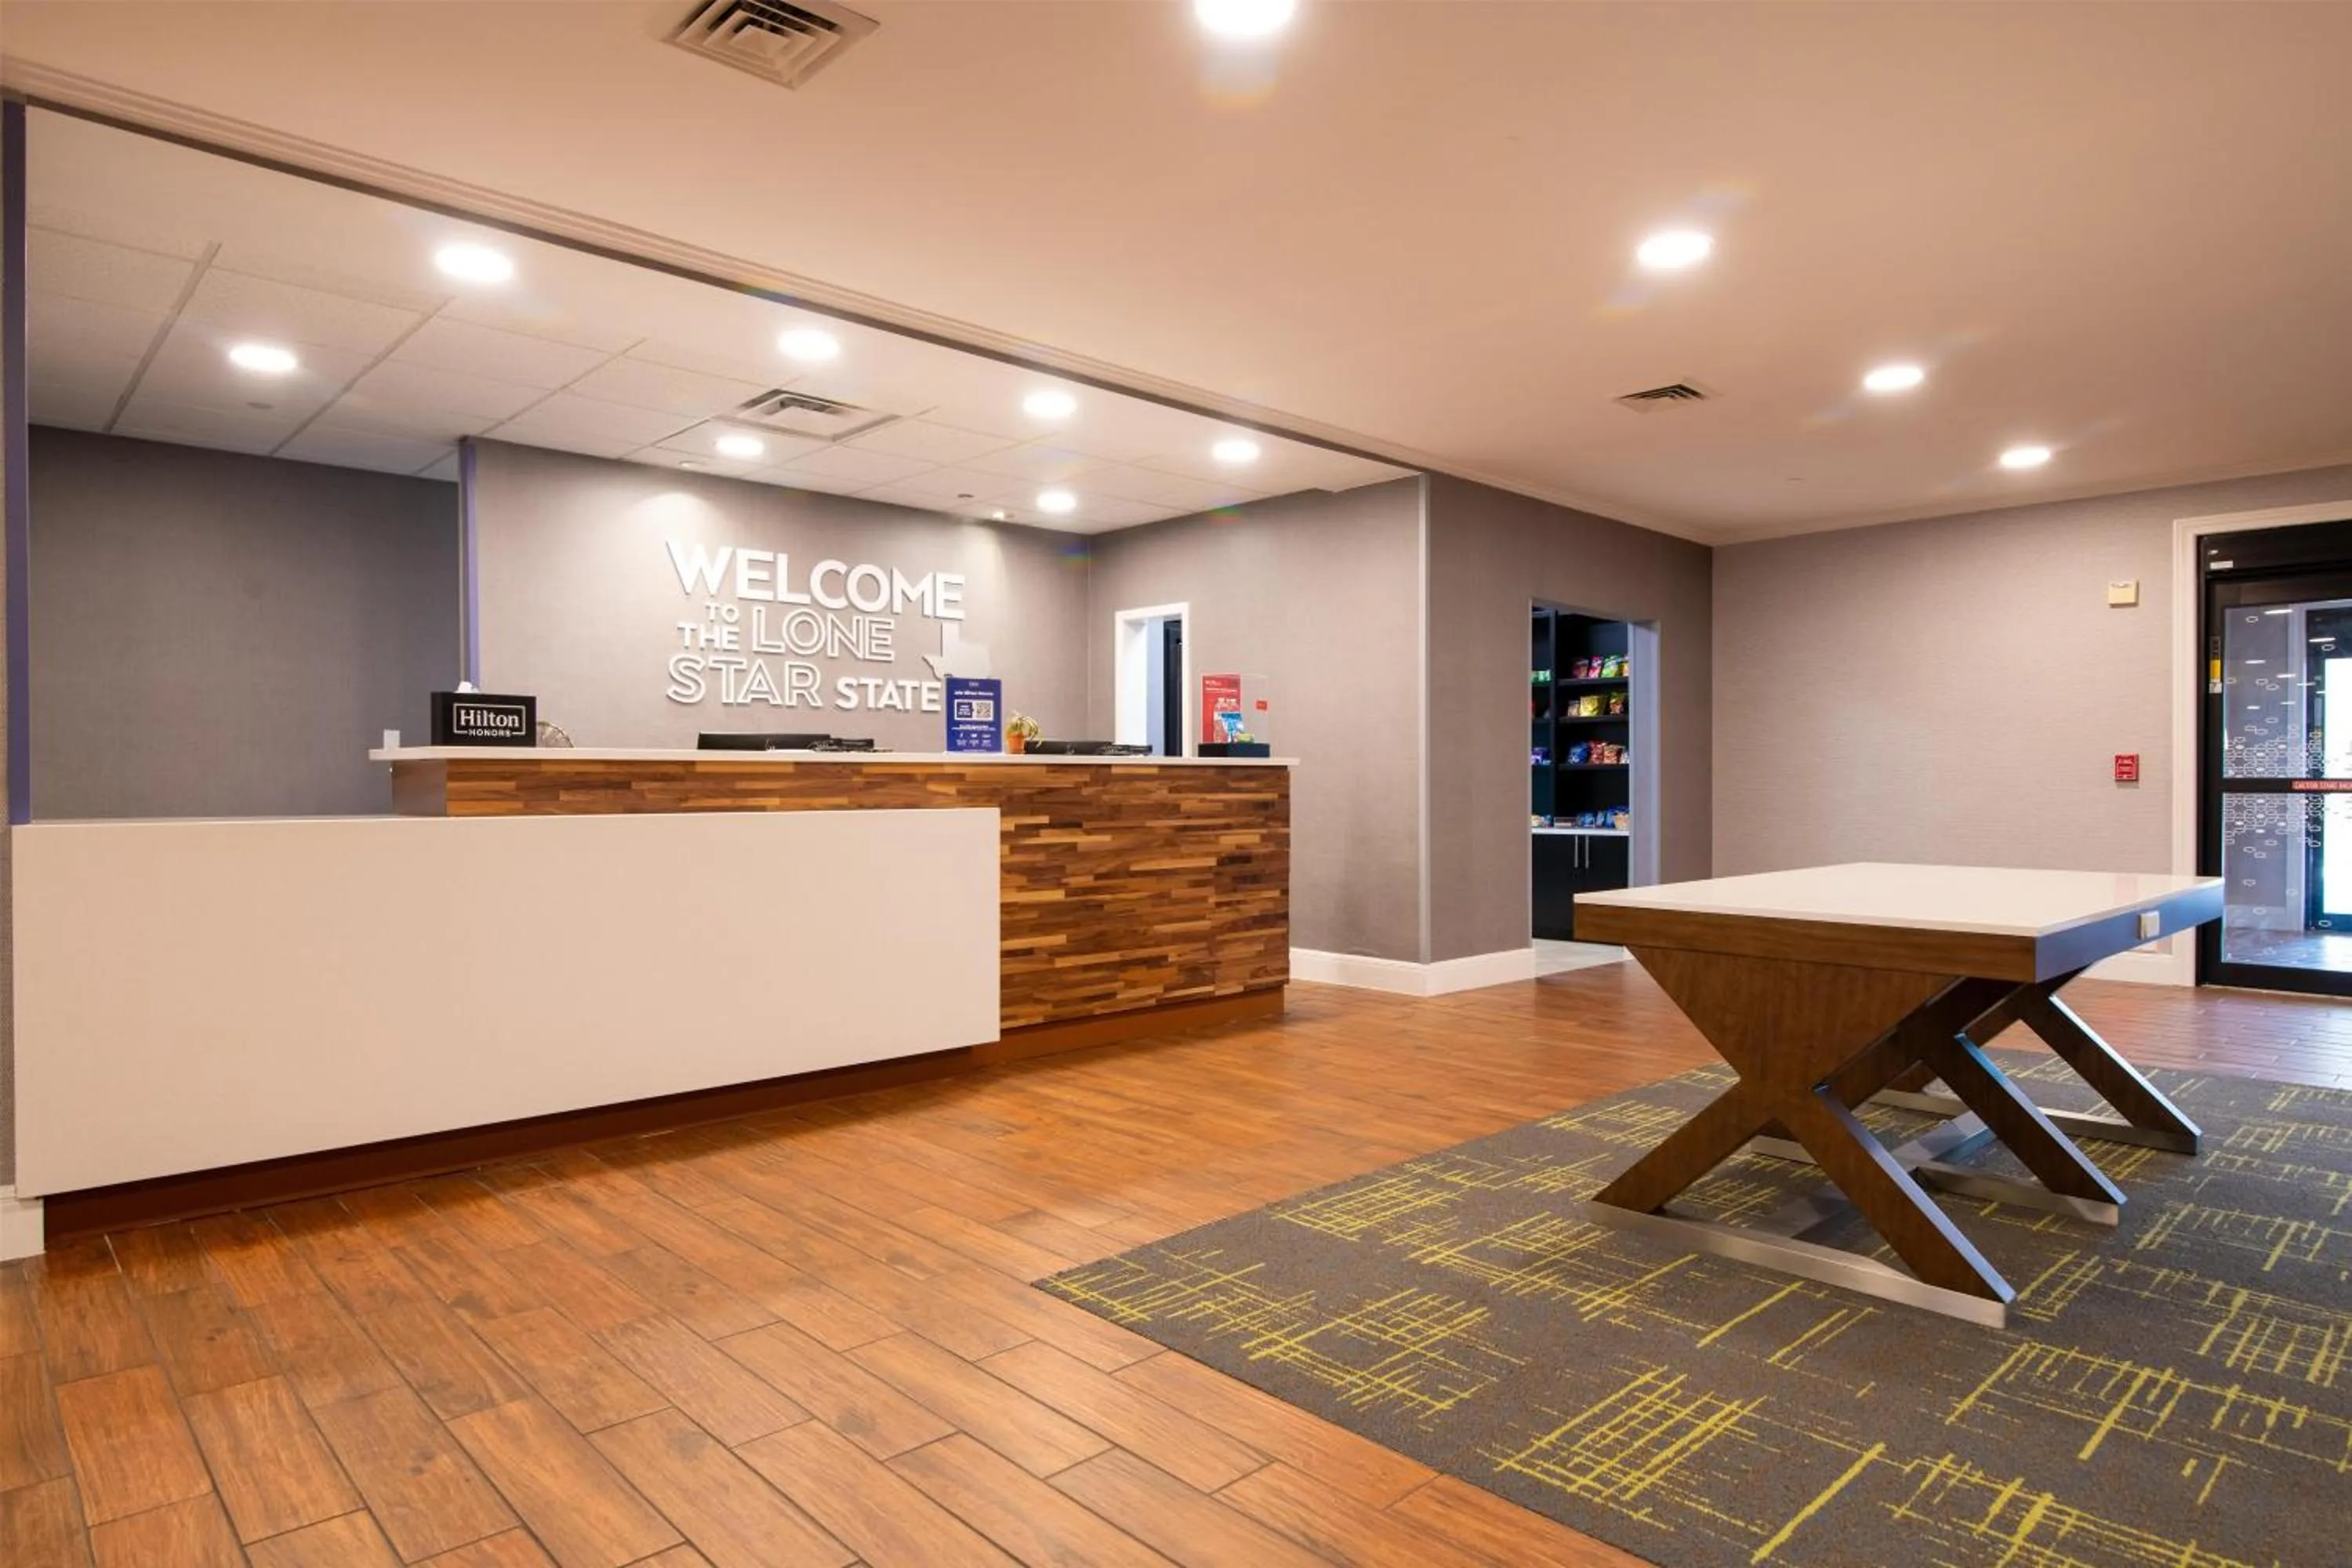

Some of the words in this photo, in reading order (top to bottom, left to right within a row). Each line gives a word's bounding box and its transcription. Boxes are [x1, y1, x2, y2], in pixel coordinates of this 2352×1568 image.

[666, 540, 965, 621] WELCOME
[704, 601, 740, 623] TO
[677, 622, 740, 652] THE
[752, 606, 895, 662] LONE
[666, 654, 824, 707] STAR
[835, 677, 942, 712] STATE
[460, 710, 519, 728] Hilton
[469, 728, 511, 737] HONORS
